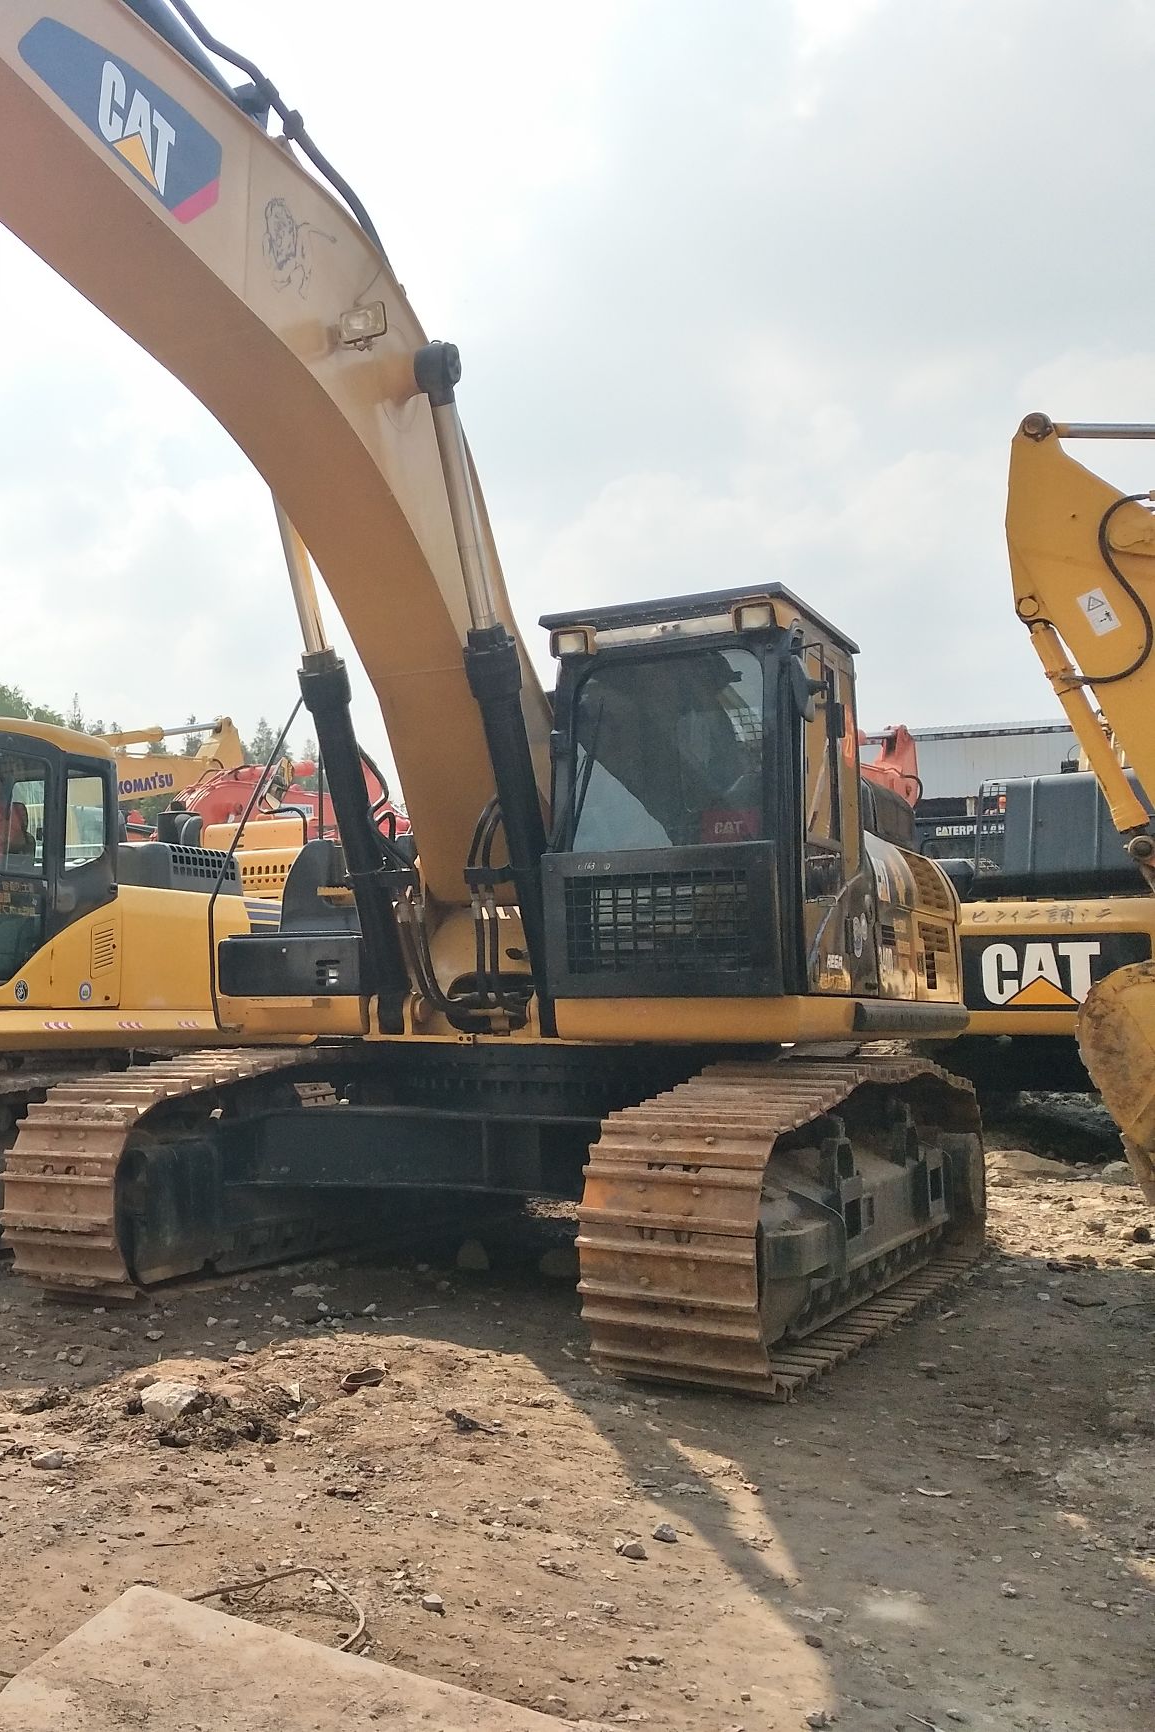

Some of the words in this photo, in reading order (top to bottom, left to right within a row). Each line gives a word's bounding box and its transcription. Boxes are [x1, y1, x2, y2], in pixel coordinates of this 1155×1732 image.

[98, 60, 176, 197] CAT
[714, 821, 743, 834] CAT
[935, 823, 1006, 836] CATERPILAR
[981, 942, 1101, 1005] CAT
